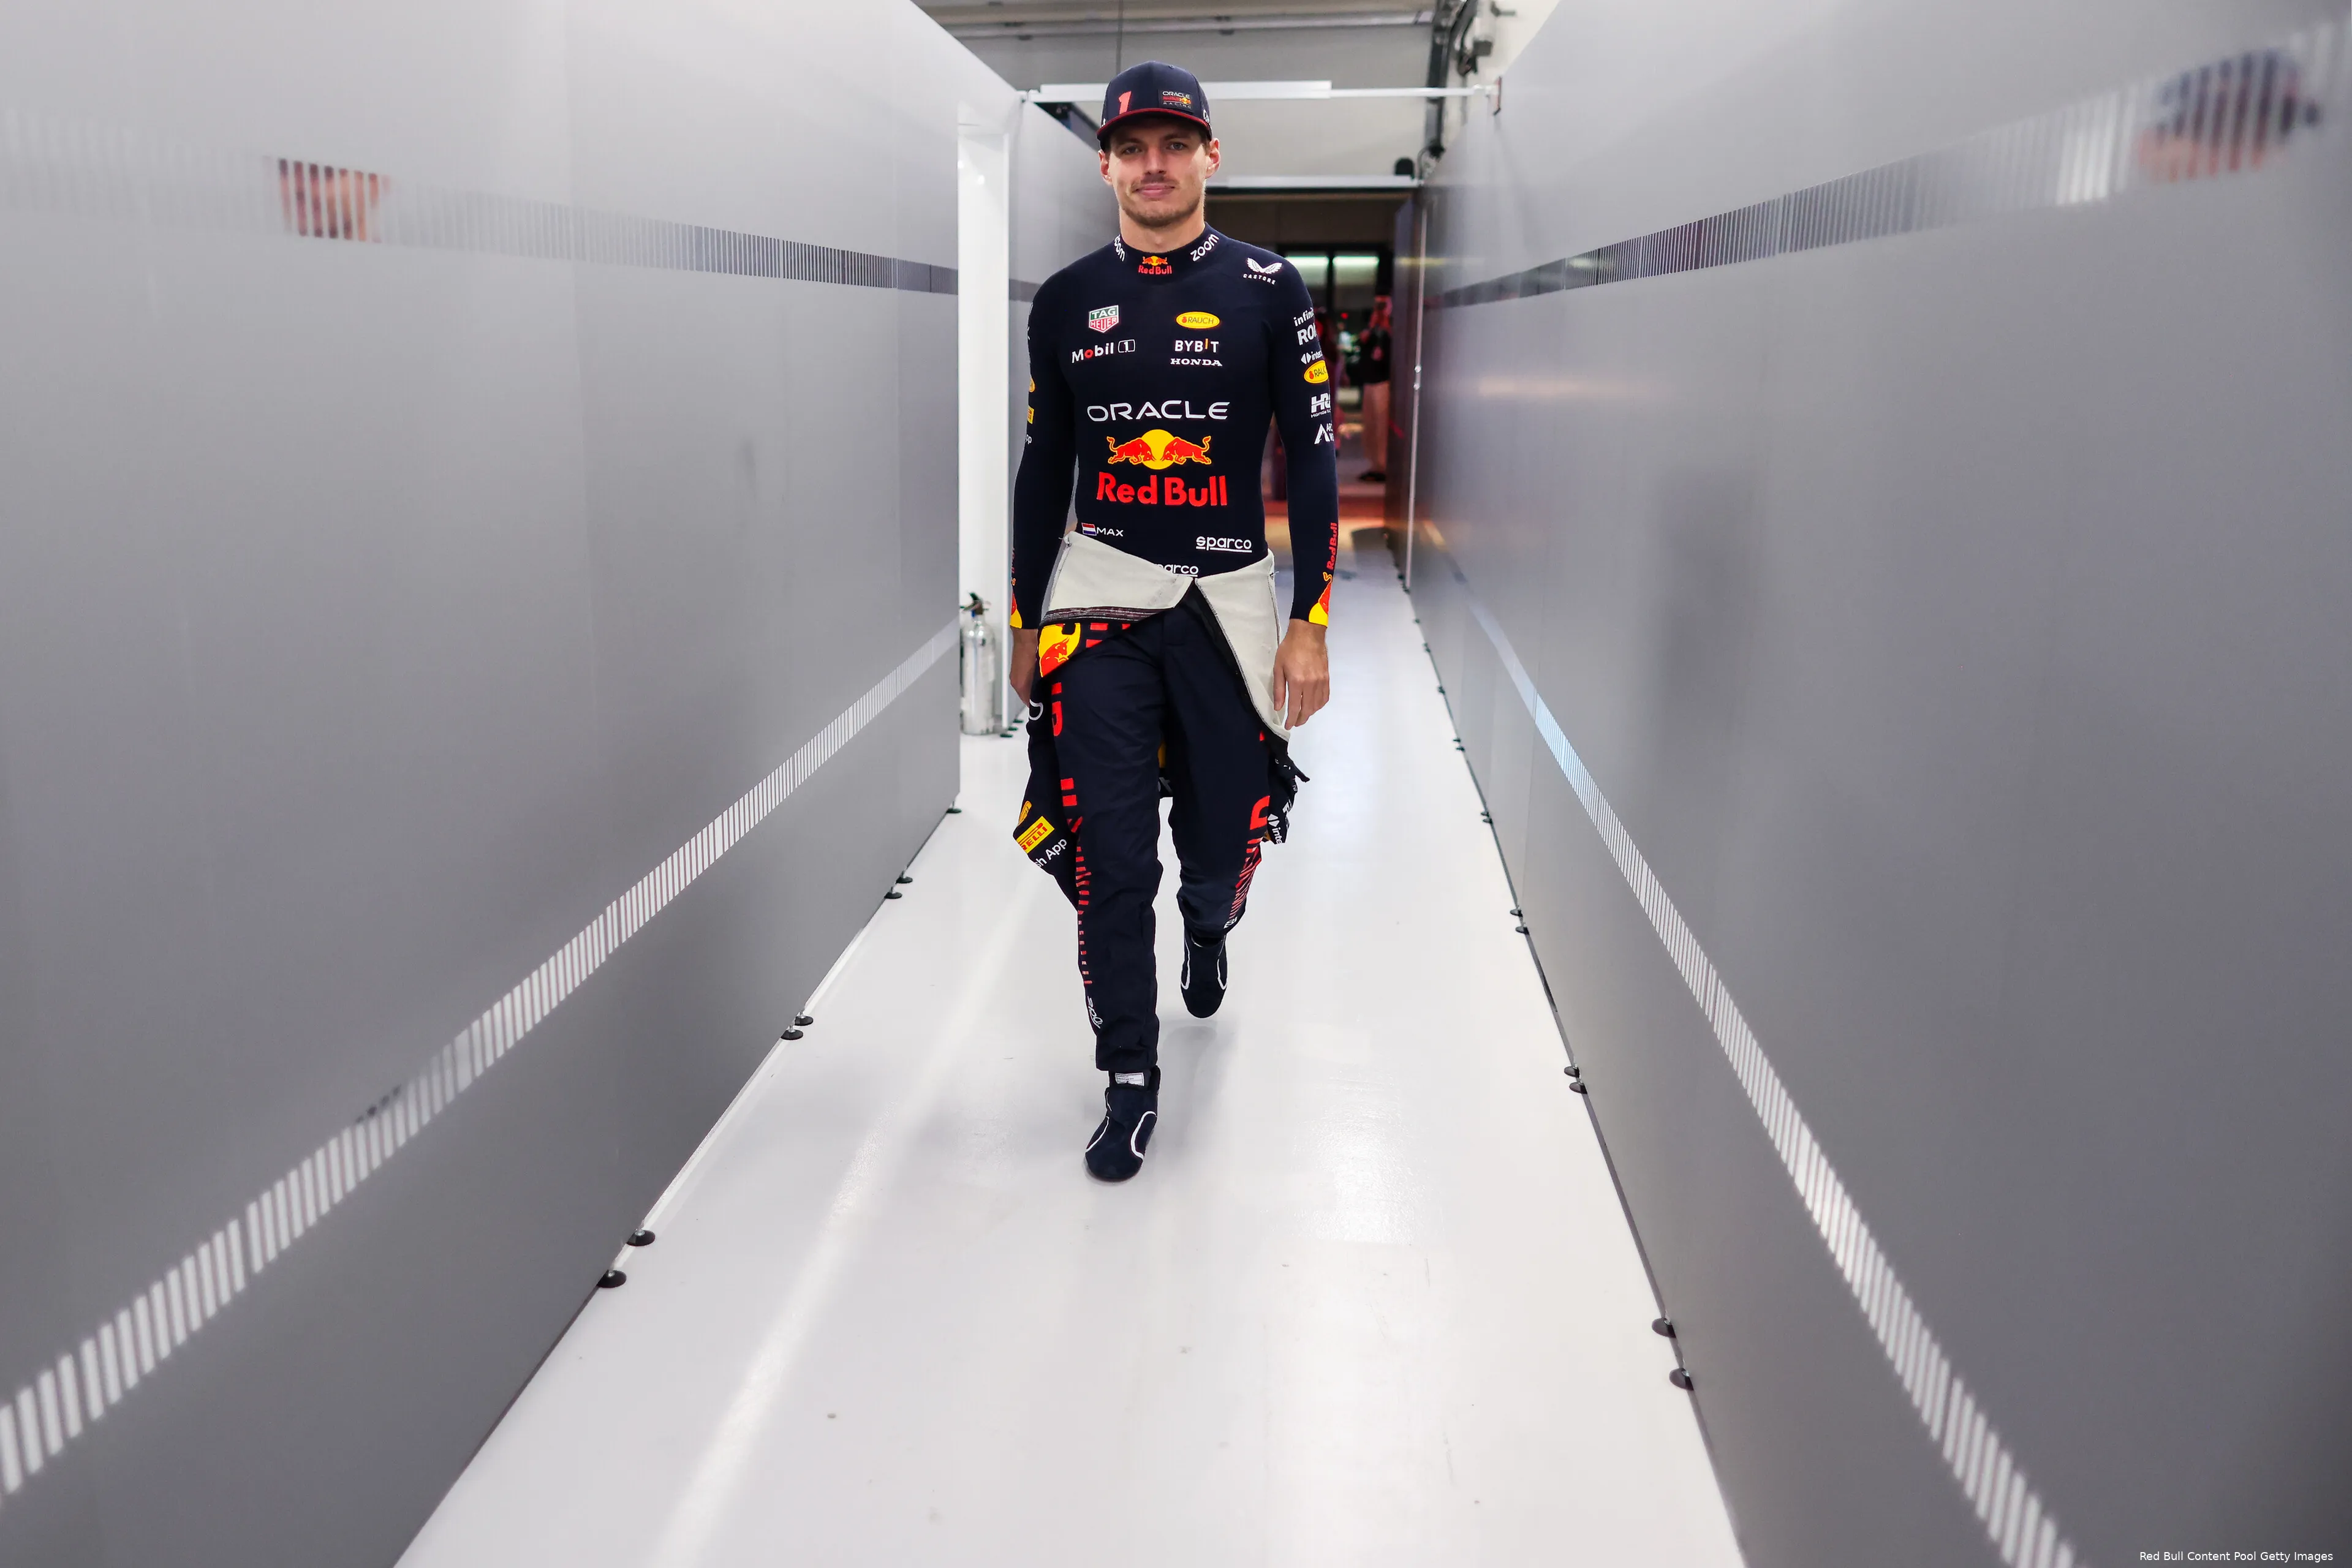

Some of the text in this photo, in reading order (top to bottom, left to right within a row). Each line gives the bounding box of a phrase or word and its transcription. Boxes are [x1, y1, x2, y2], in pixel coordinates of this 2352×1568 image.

[1162, 91, 1190, 99] ORACLE
[1118, 91, 1132, 115] 1
[1114, 234, 1125, 262] oom
[1190, 234, 1219, 262] zoom
[1138, 265, 1173, 274] Red Bull
[1243, 273, 1276, 285] CASTORE
[1092, 307, 1116, 319] TAG
[1091, 317, 1117, 331] HEUER
[1072, 342, 1114, 363] Mobil
[1174, 338, 1219, 353] BYBIT
[1170, 358, 1223, 366] HONDA
[1087, 400, 1230, 422] ORACLE
[1096, 472, 1227, 507] Red Bull
[1097, 527, 1124, 537] MAX
[1196, 535, 1252, 551] sparco
[1045, 839, 1067, 861] App
